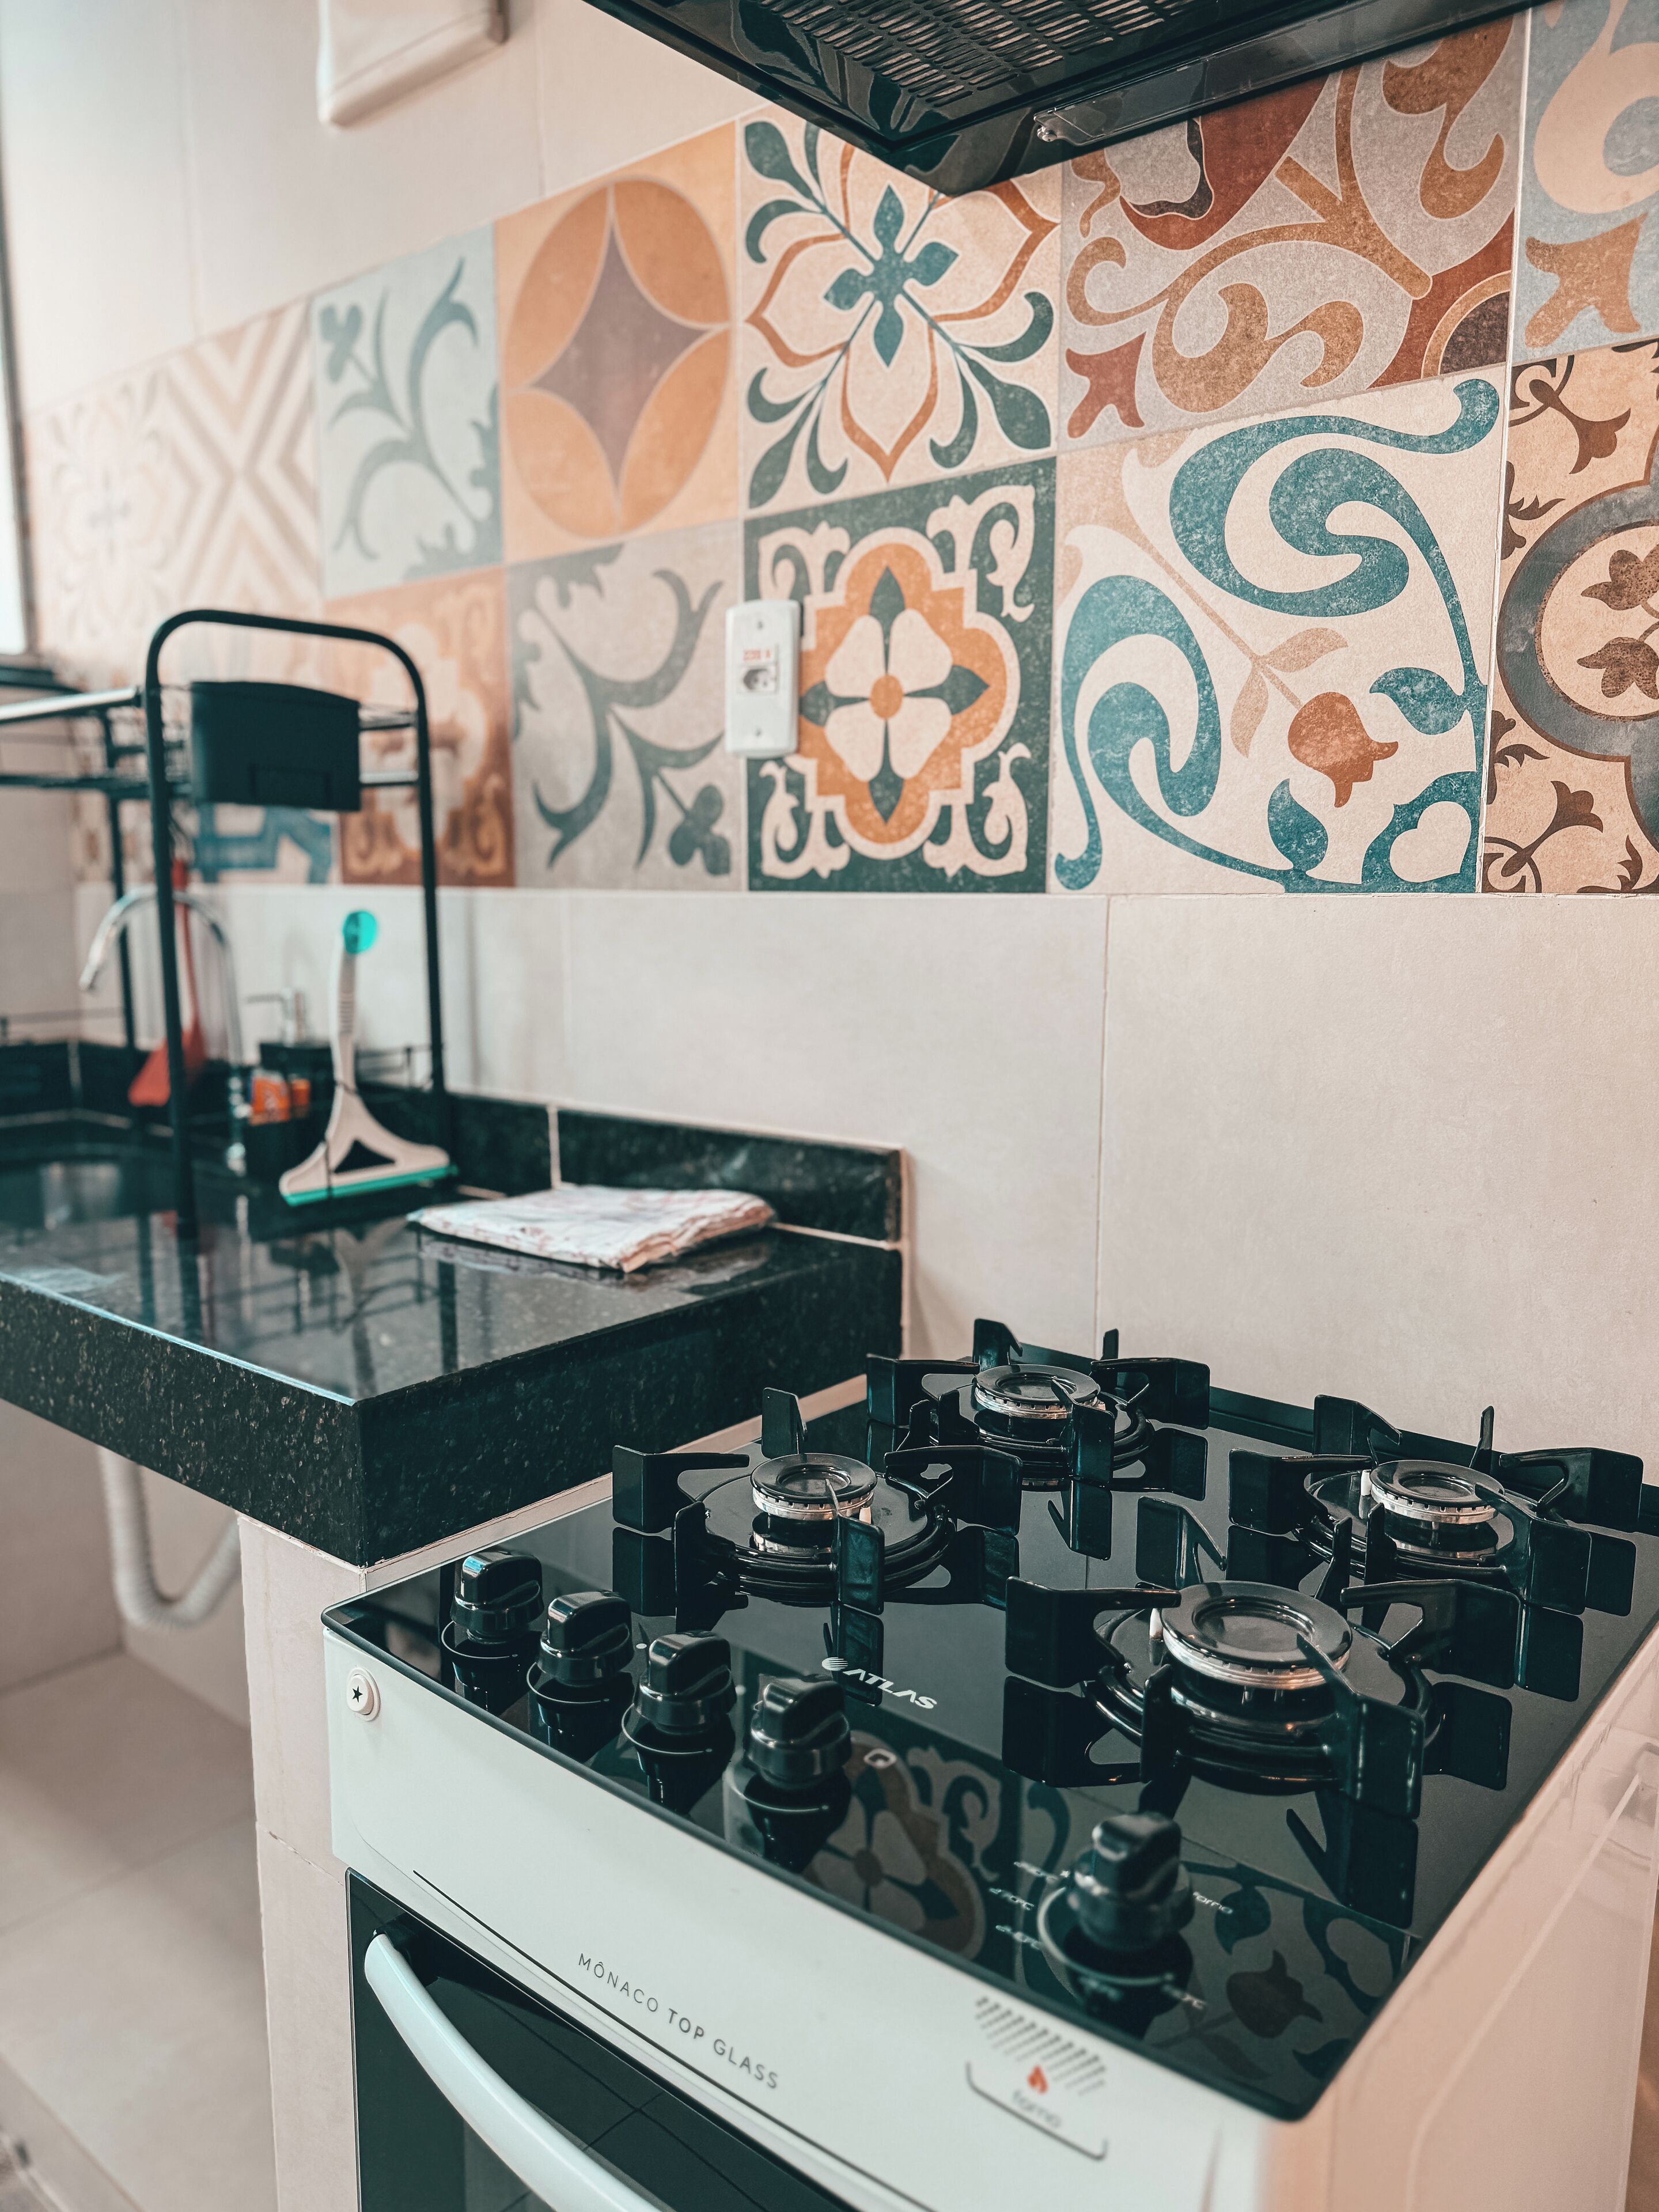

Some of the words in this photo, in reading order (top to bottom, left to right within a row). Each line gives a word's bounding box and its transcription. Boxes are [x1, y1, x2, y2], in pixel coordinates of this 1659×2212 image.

[843, 1668, 938, 1709] ATLAS
[578, 1953, 658, 2012] MÔNACO
[668, 2008, 705, 2040] TOP
[713, 2038, 778, 2089] GLASS
